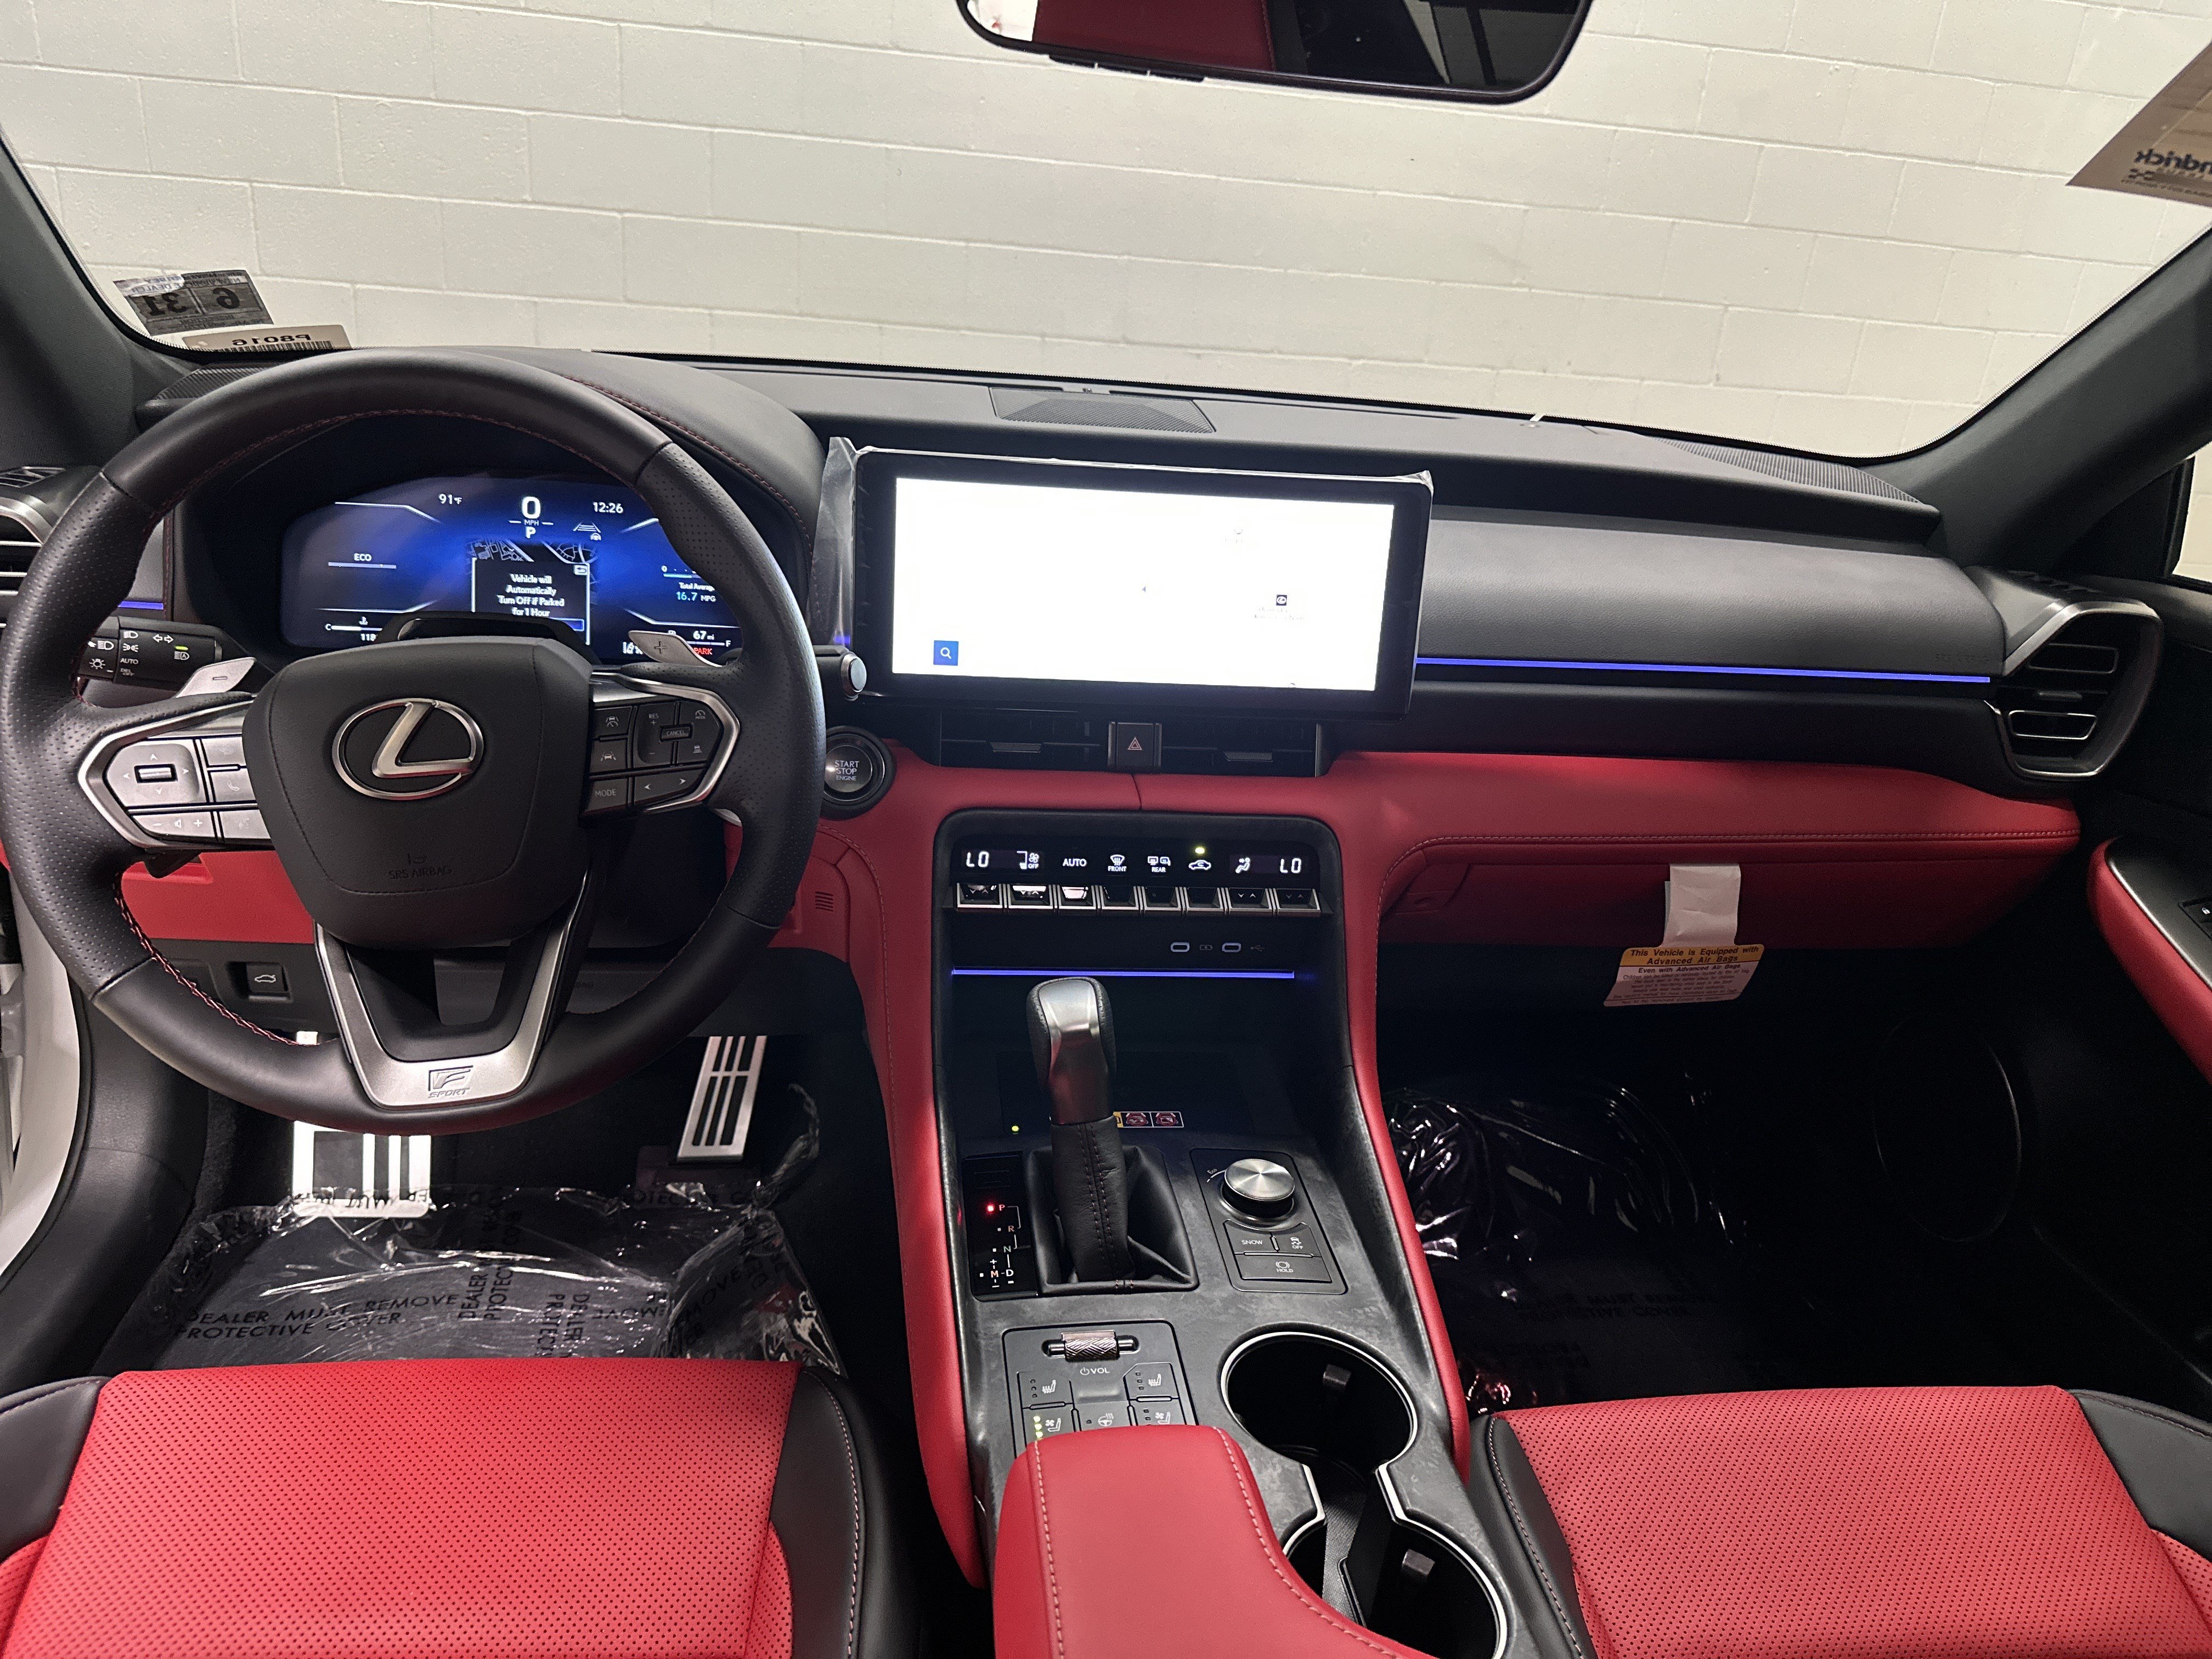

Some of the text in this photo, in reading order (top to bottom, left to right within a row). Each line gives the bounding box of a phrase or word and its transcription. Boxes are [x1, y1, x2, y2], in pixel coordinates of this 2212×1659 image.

[521, 496, 541, 519] 0
[592, 501, 624, 514] 12:26
[526, 527, 535, 538] P
[353, 553, 372, 561] ECO
[510, 573, 552, 584] Vehicle will
[505, 584, 557, 596] Automatically
[693, 583, 715, 592] Averag
[516, 596, 531, 605] Off
[531, 596, 538, 605] if
[539, 597, 565, 606] Parked
[675, 591, 698, 601] 16.7
[511, 607, 550, 617] for 1 Hour
[693, 630, 707, 640] 67
[725, 640, 731, 648] F
[693, 647, 713, 655] PARK
[834, 760, 860, 768] START
[595, 788, 617, 797] MODE
[1062, 858, 1087, 867] AUTO
[1700, 947, 1739, 956] Equipped
[428, 1088, 471, 1099] SPORT
[990, 1269, 1014, 1278] M D
[364, 1294, 459, 1312] REMOVE
